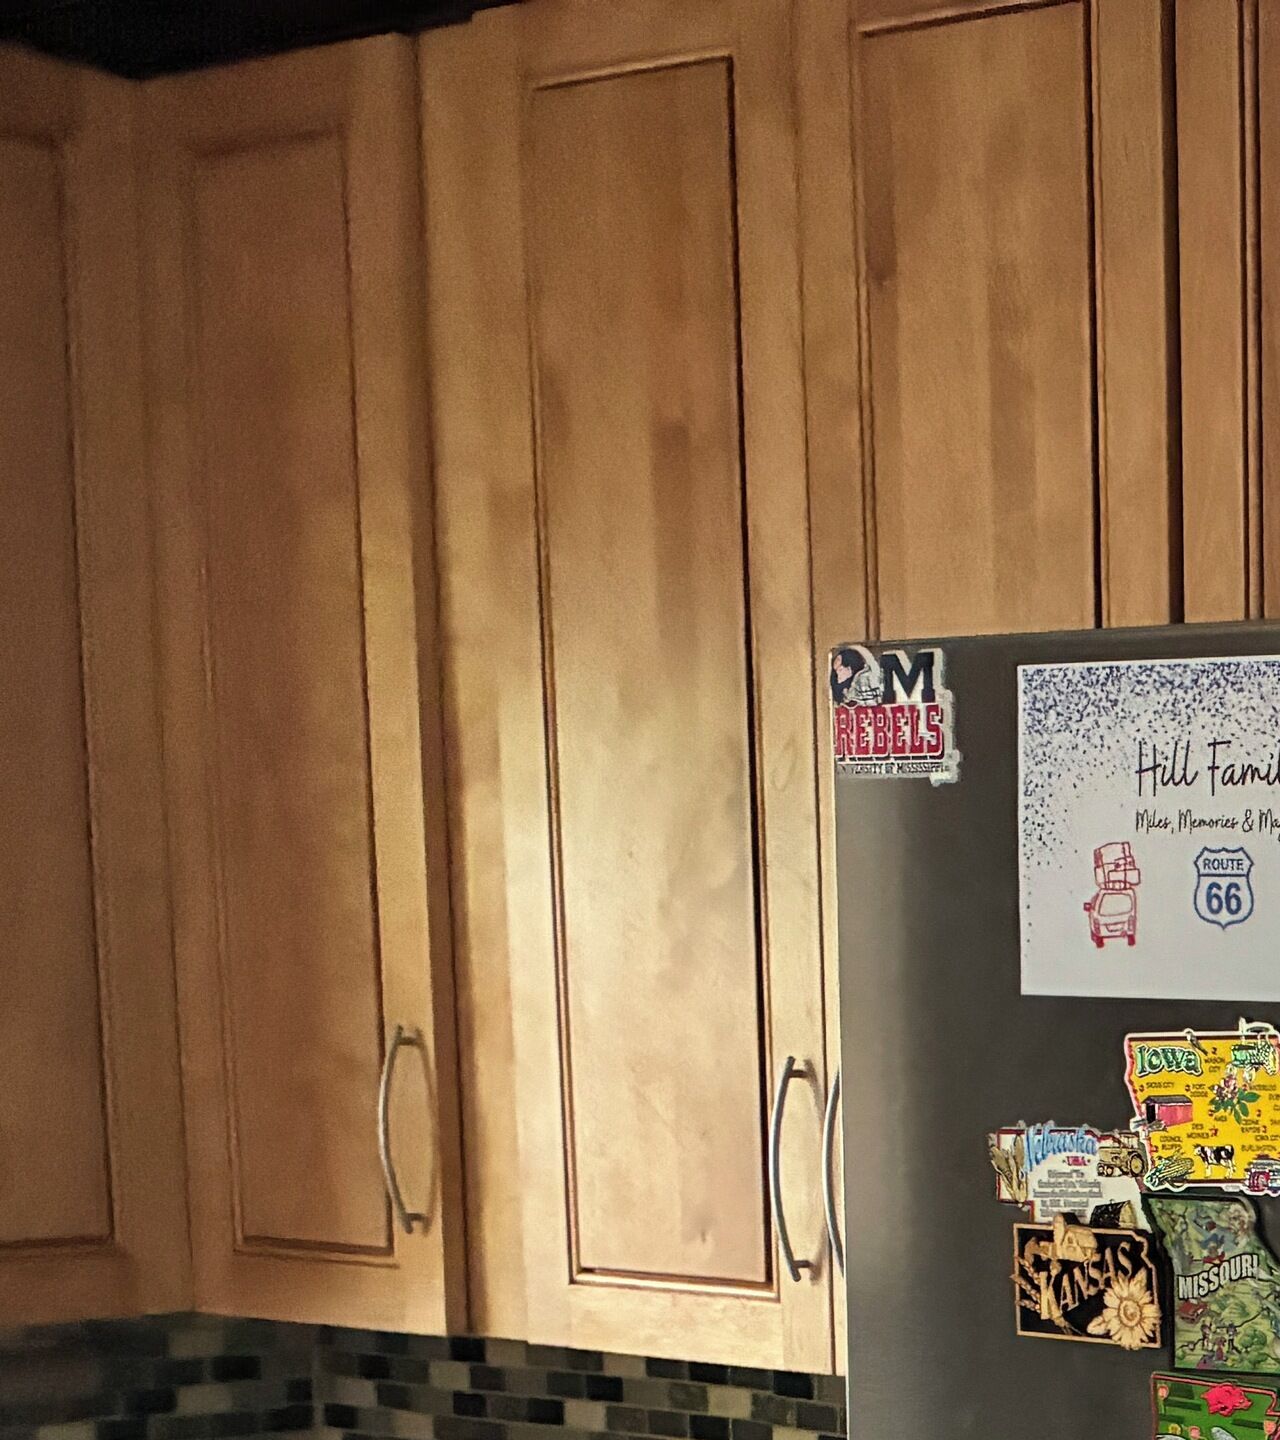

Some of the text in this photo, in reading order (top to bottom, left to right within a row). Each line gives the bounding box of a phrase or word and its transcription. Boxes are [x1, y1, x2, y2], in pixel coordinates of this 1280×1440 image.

[834, 703, 945, 760] REBELS
[1135, 739, 1199, 797] Hill
[1135, 809, 1175, 834] Miles,
[1178, 808, 1239, 835] Memories
[1241, 808, 1254, 833] &
[1203, 857, 1244, 872] ROUTE
[1205, 881, 1242, 915] 66
[1040, 1242, 1132, 1320] KANSAS
[1178, 1254, 1258, 1299] MISSOURI
